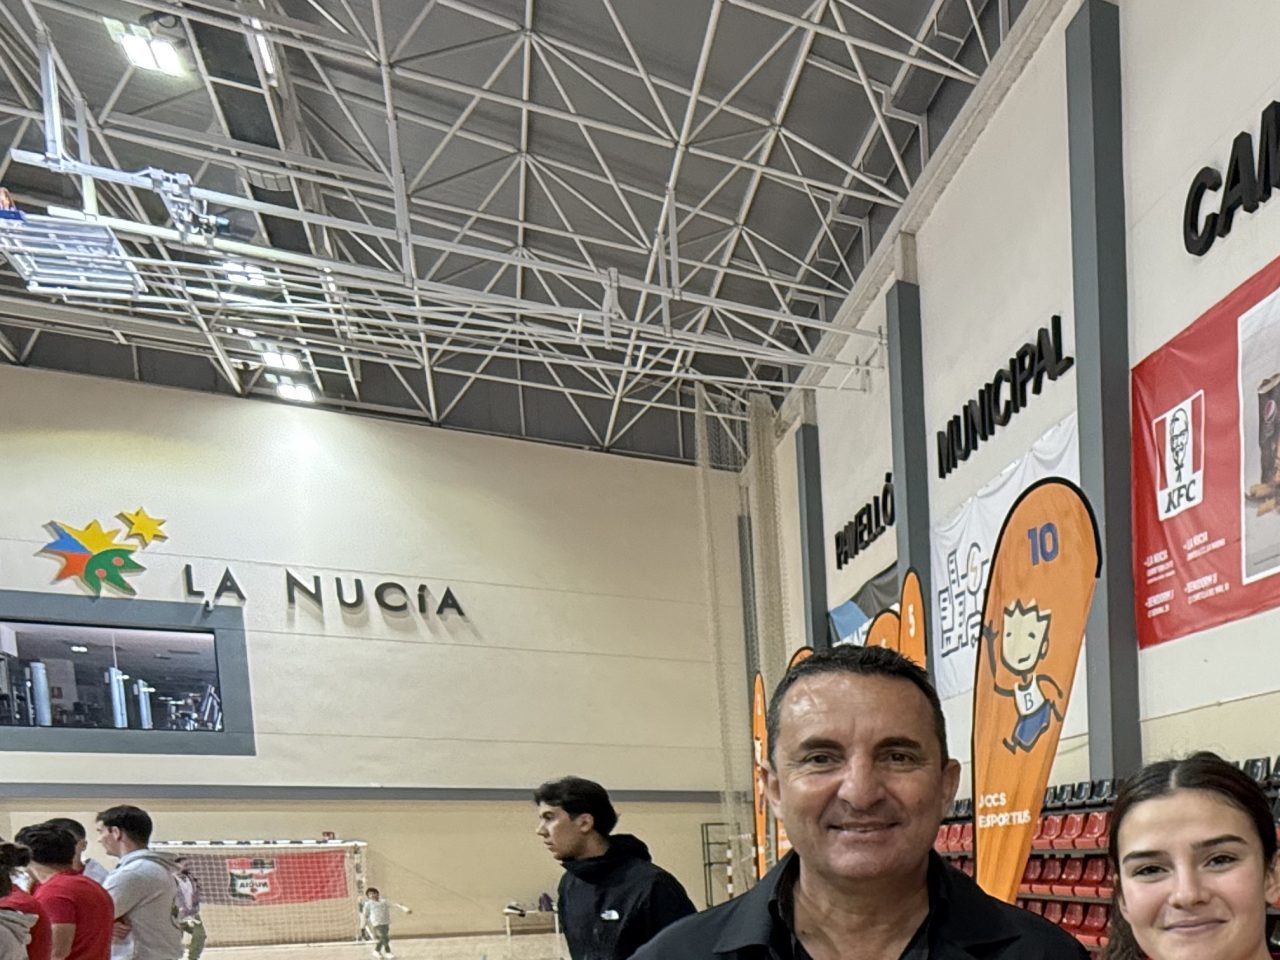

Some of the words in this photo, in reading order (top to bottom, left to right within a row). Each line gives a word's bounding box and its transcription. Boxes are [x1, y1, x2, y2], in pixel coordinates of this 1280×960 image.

[937, 315, 1074, 479] MUNICIPAL
[1164, 477, 1196, 514] KFC
[834, 472, 895, 570] PAVELLÓ
[1027, 521, 1060, 566] 10
[184, 563, 247, 601] LA
[979, 792, 1007, 808] JOCS
